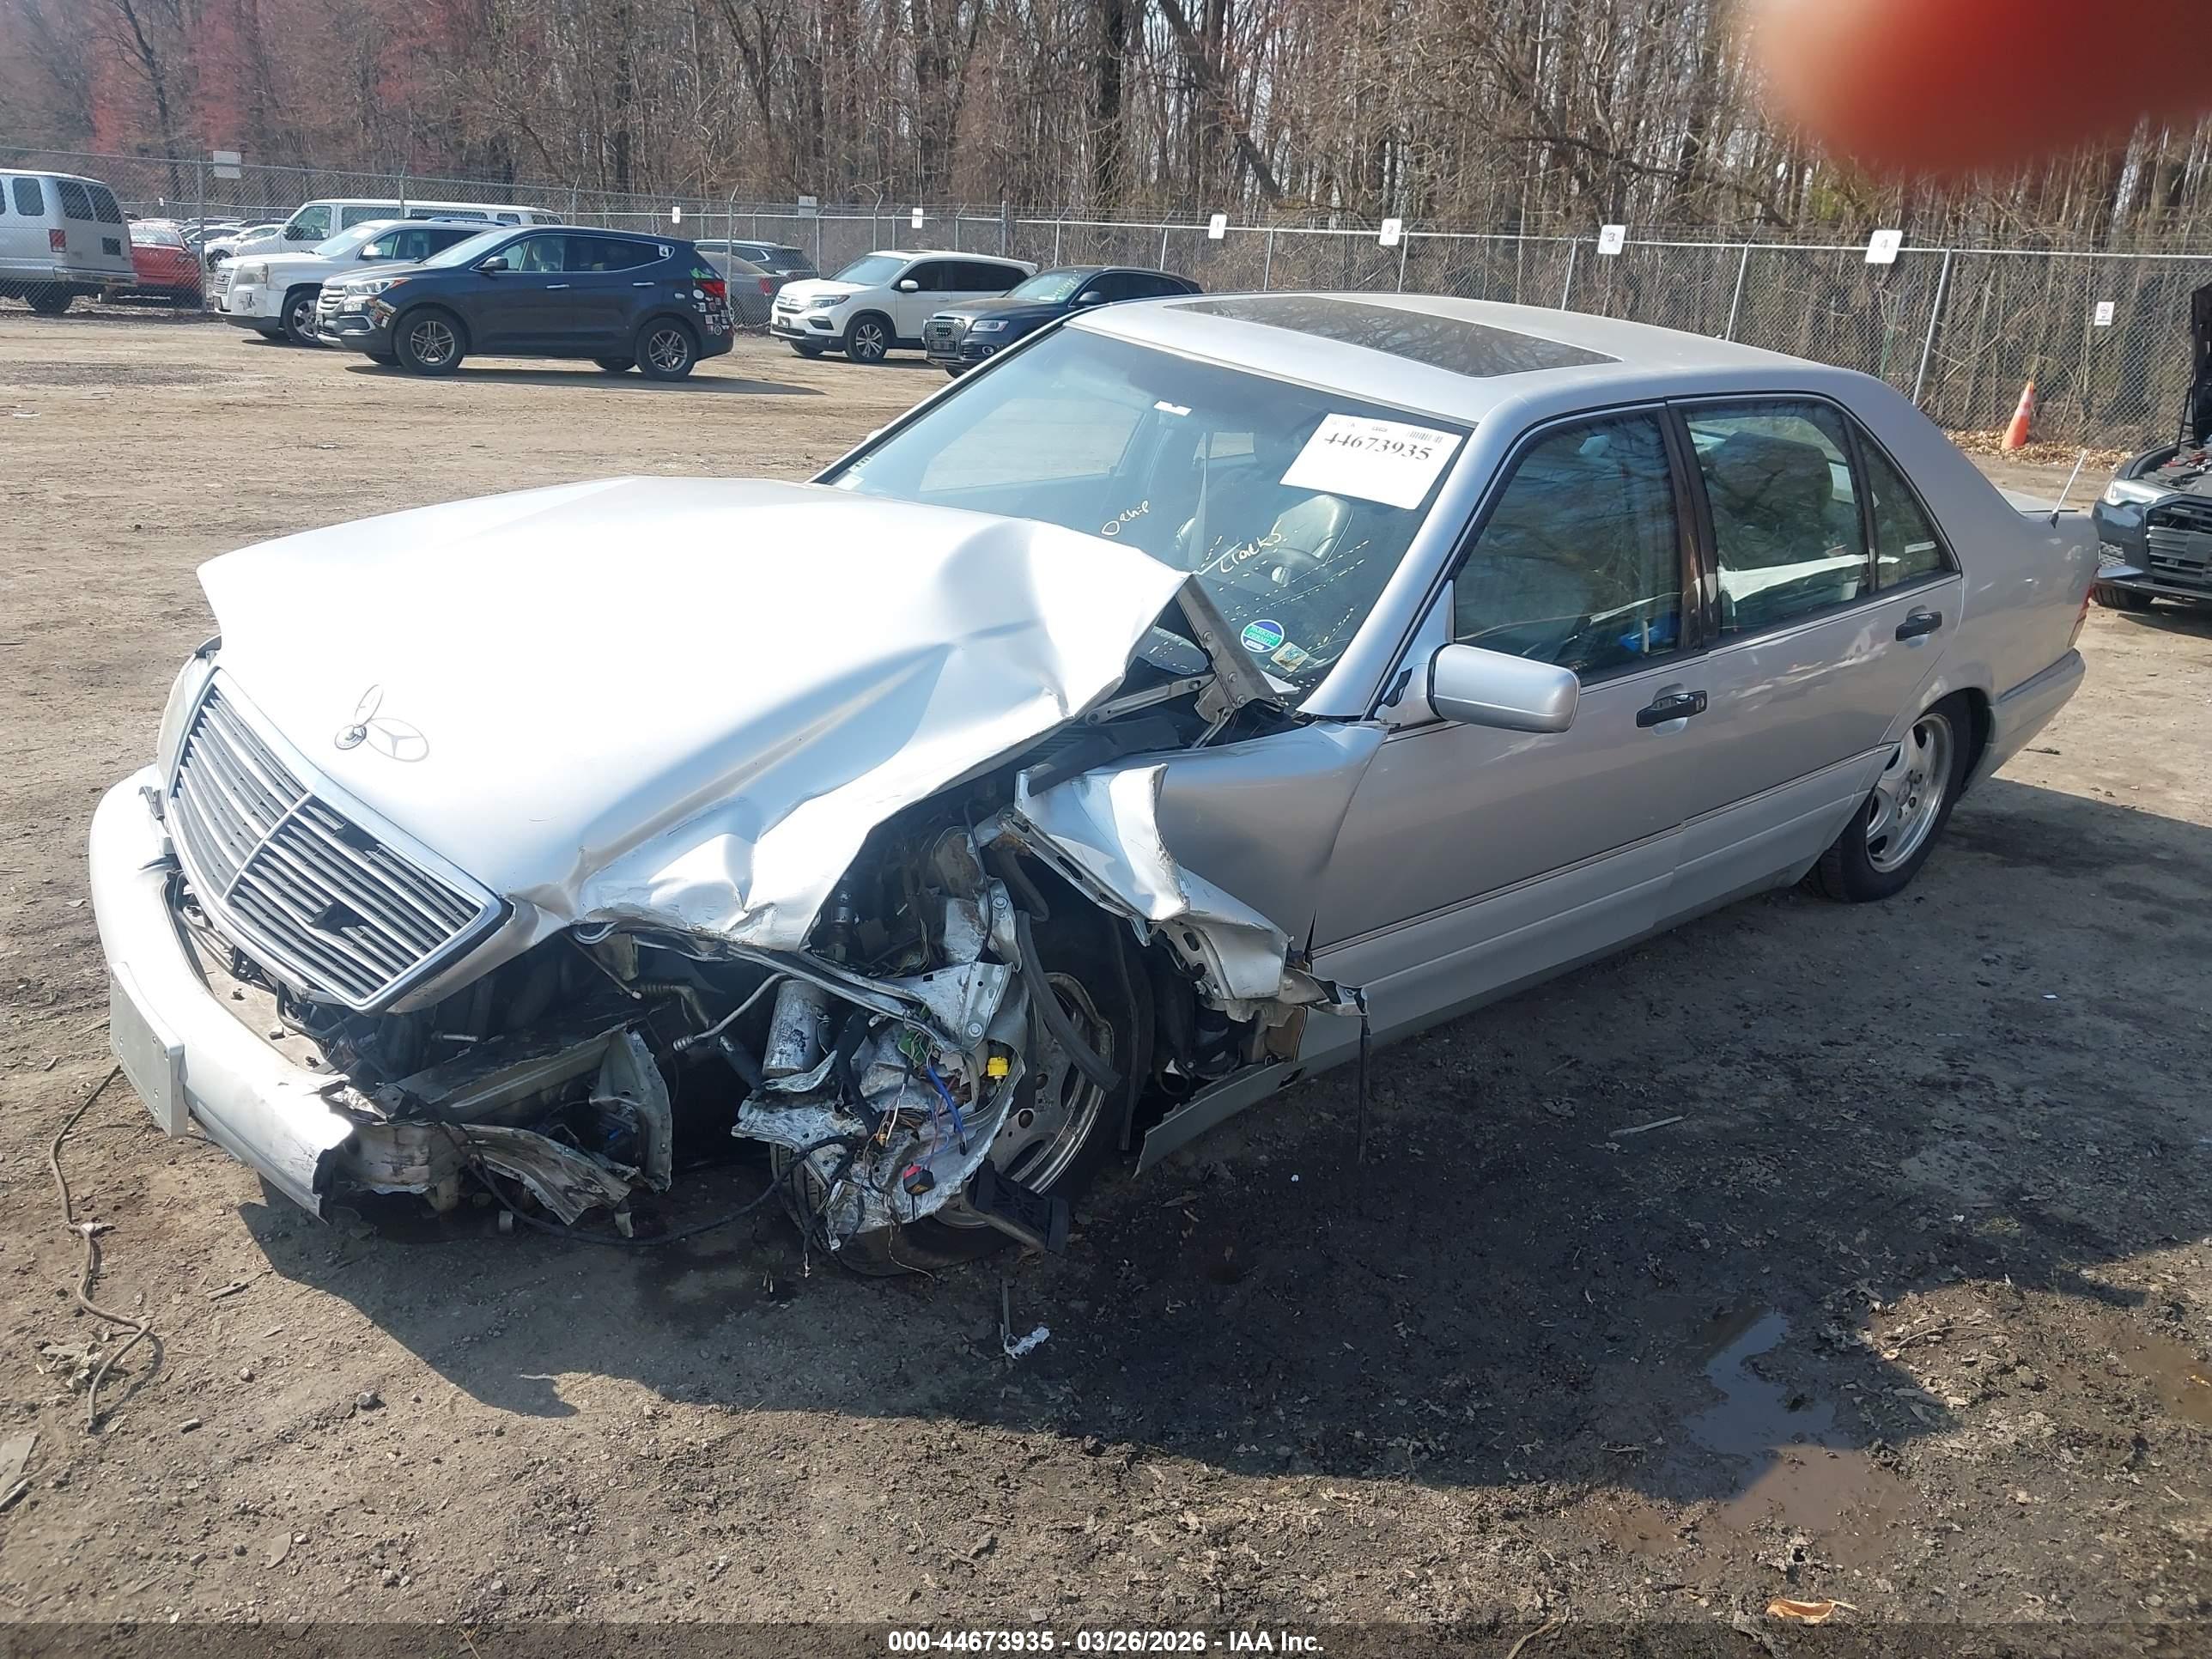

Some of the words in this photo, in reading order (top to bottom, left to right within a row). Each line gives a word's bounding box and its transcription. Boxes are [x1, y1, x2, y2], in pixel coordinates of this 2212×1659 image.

[1387, 225, 1395, 234] 2
[1607, 232, 1615, 242] 3
[1880, 239, 1888, 250] 4
[1324, 432, 1434, 460] 44673935
